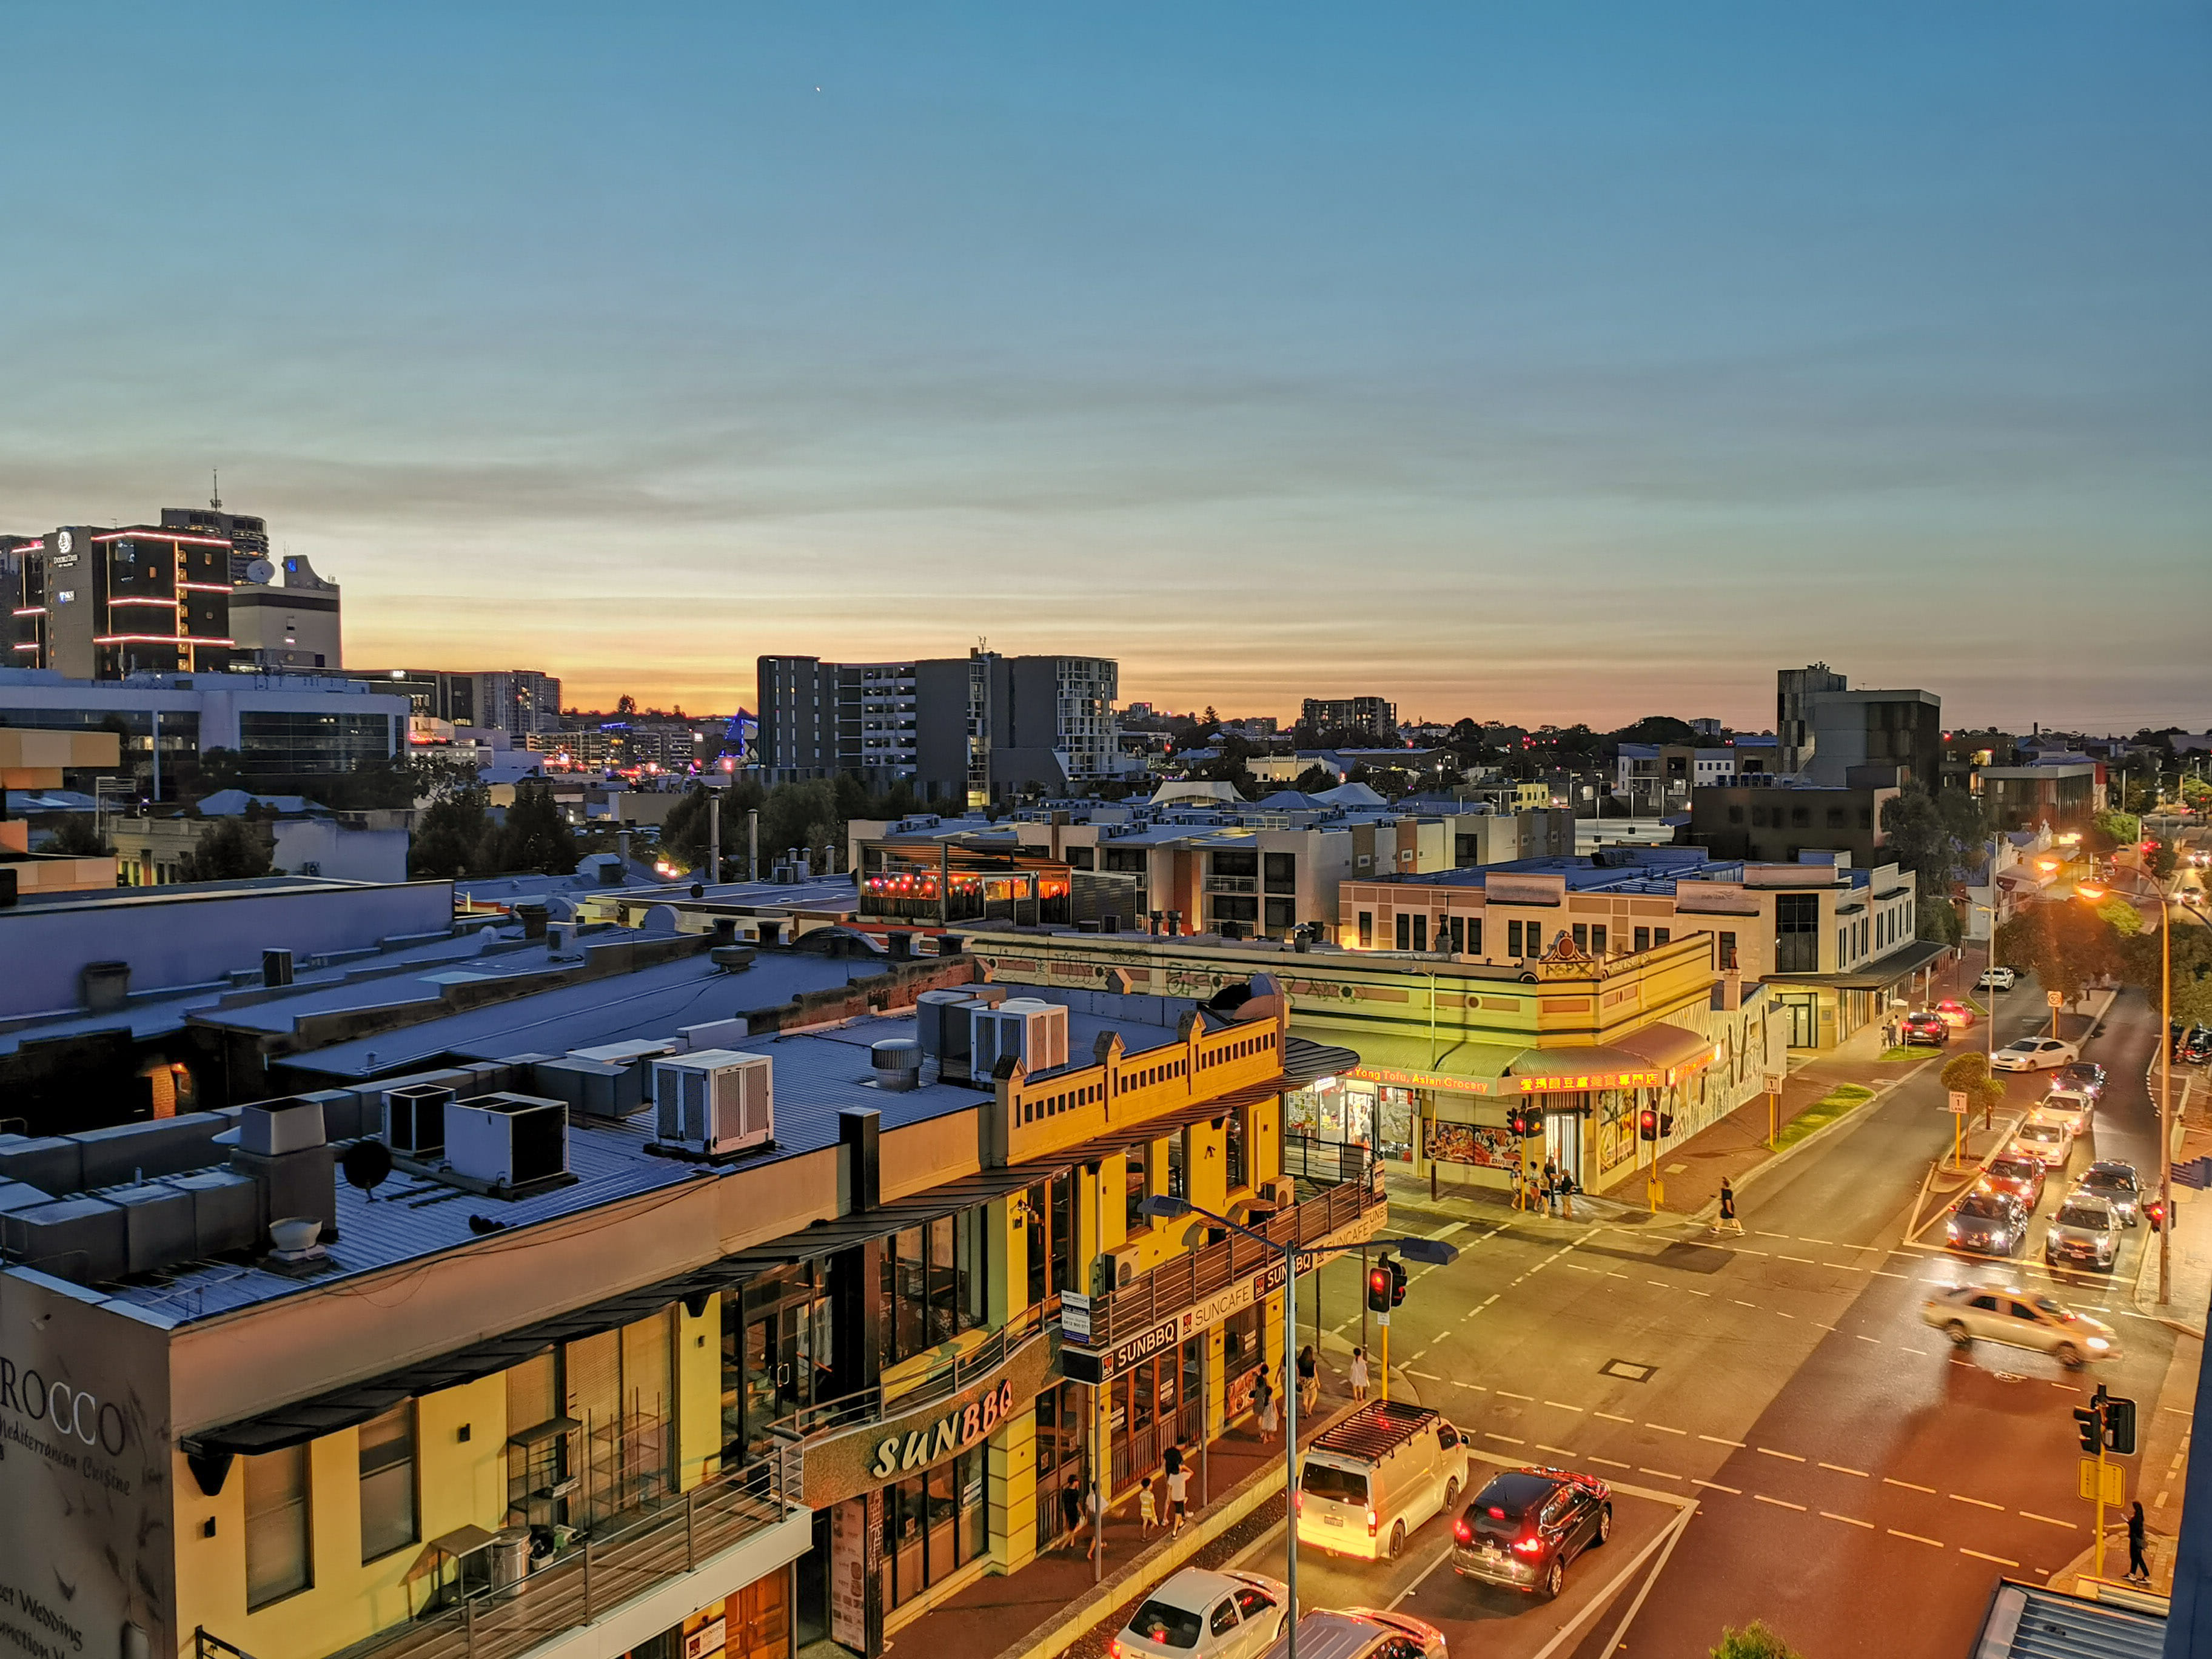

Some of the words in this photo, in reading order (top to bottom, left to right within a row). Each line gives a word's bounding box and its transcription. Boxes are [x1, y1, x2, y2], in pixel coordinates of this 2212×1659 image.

[1355, 1067, 1381, 1081] Yong
[1382, 1070, 1409, 1084] Tofu,
[1412, 1073, 1441, 1087] Asian
[1443, 1077, 1489, 1093] Grocery
[1267, 1253, 1311, 1289] SUNBQ
[1195, 1285, 1249, 1326] SUNCAFE
[1118, 1323, 1175, 1368] SUNBBQ
[873, 1379, 1013, 1478] SUNBBQ
